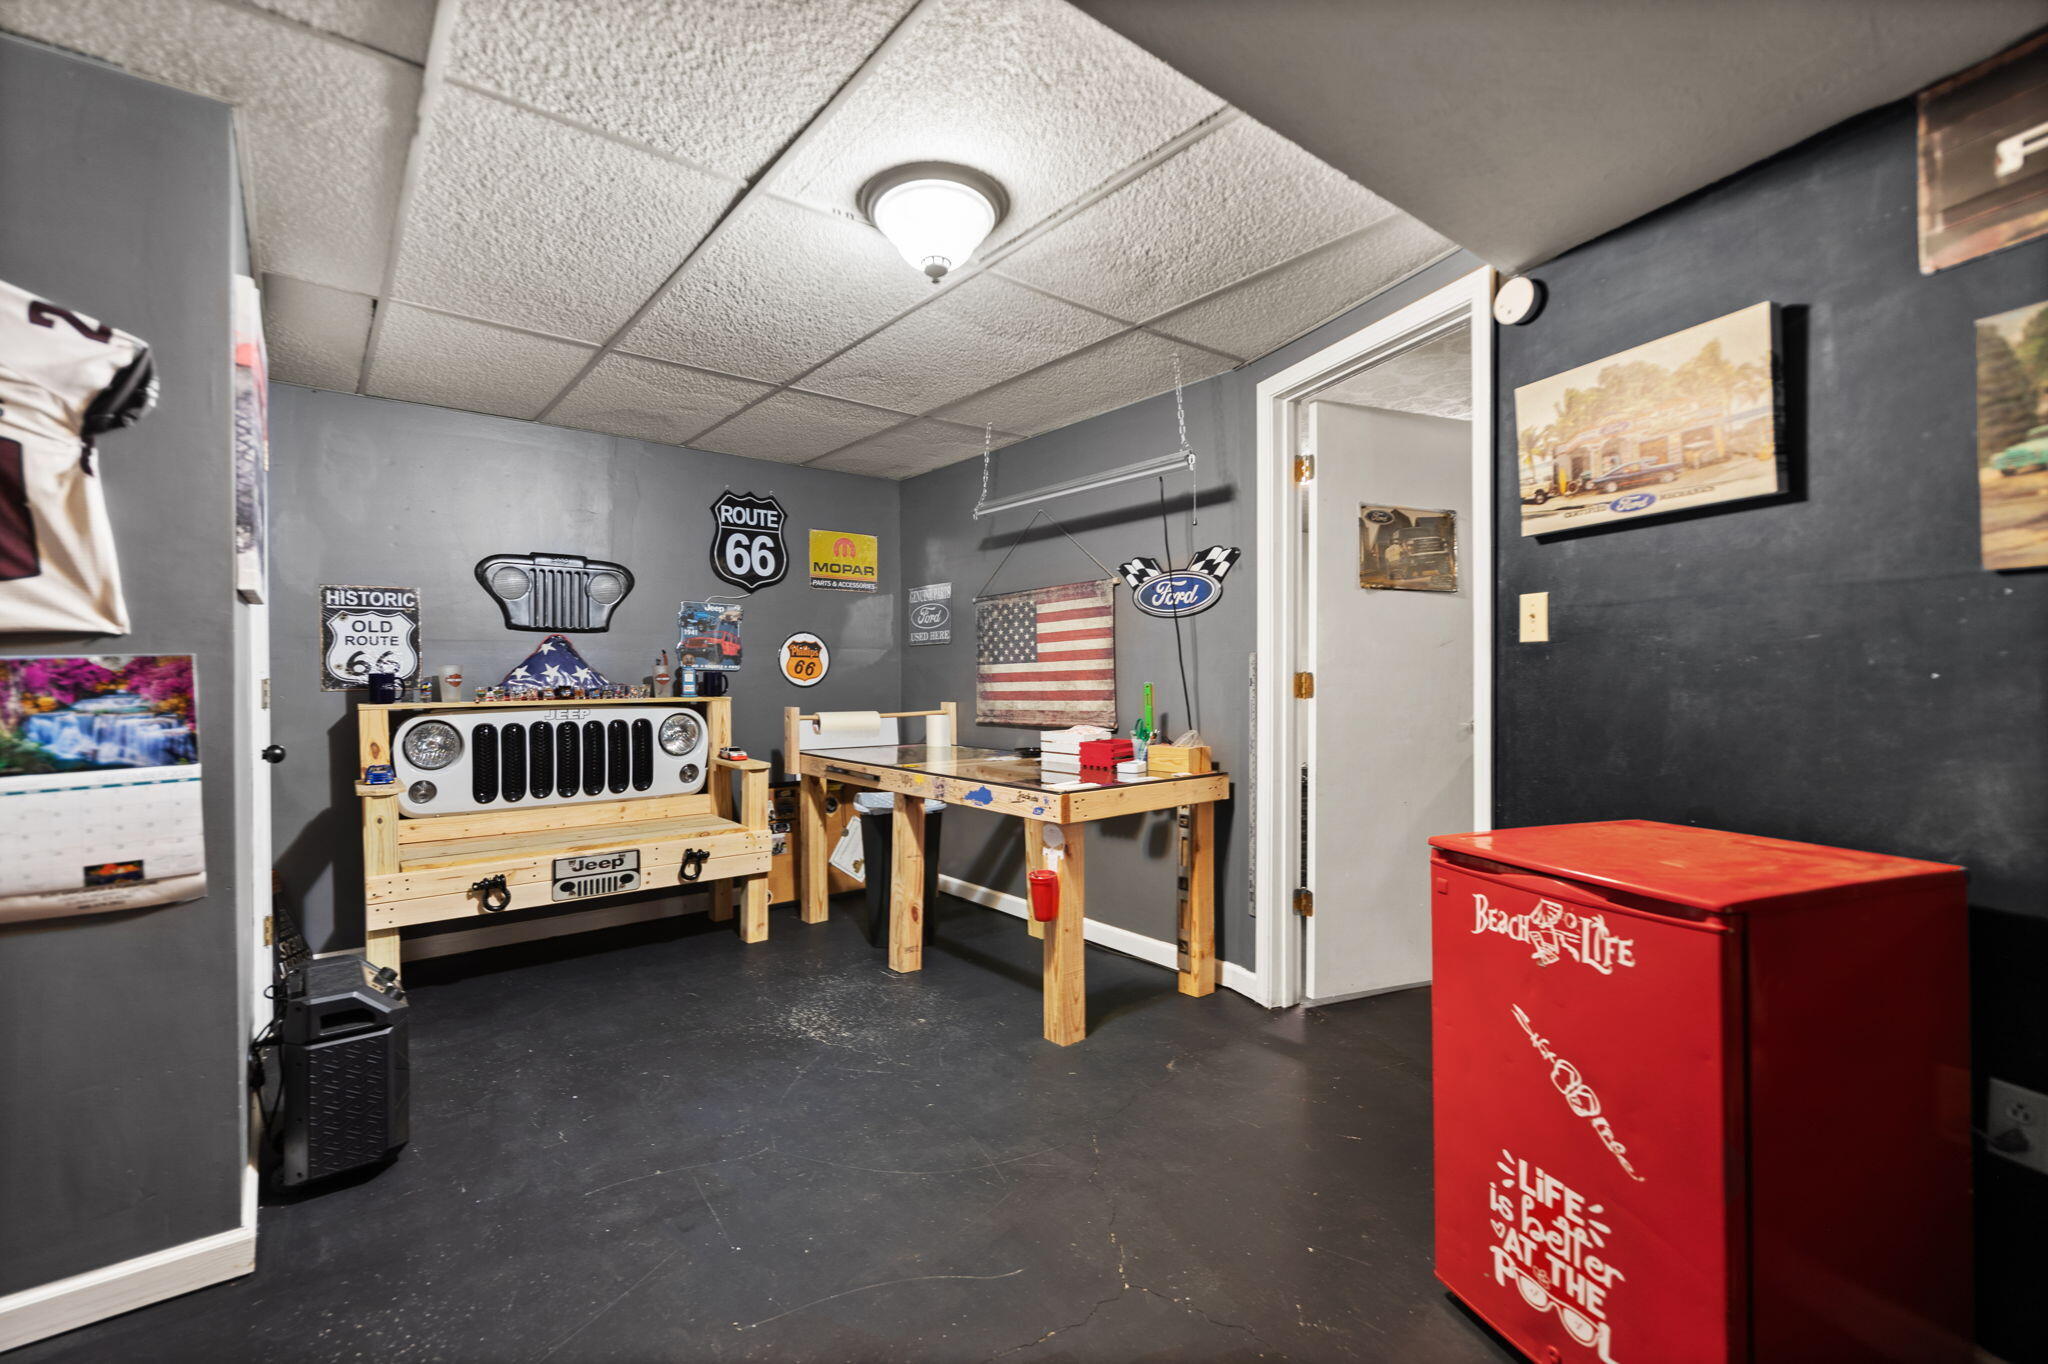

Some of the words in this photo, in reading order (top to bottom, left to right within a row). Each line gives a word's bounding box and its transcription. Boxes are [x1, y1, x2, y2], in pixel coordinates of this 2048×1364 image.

[1616, 495, 1650, 511] Ford
[720, 505, 779, 528] ROUTE
[725, 533, 776, 577] 66
[813, 562, 875, 576] MOPAR
[812, 579, 831, 588] PARTS
[832, 580, 837, 588] &
[838, 581, 876, 590] ACCESSORIES
[326, 590, 416, 607] HISTORIC
[1152, 580, 1199, 607] Ford
[704, 604, 725, 613] Jeep
[917, 606, 942, 625] Ford
[352, 620, 393, 633] OLD
[345, 636, 400, 646] ROUTE
[930, 630, 950, 640] HERE
[346, 651, 401, 677] 66
[794, 660, 816, 676] 66
[544, 709, 591, 720] JEEP
[572, 858, 624, 872] Jeep
[1489, 1182, 1514, 1222] is
[1521, 1194, 1626, 1289] better
[1503, 1227, 1538, 1267] AT
[1545, 1252, 1607, 1320] THE
